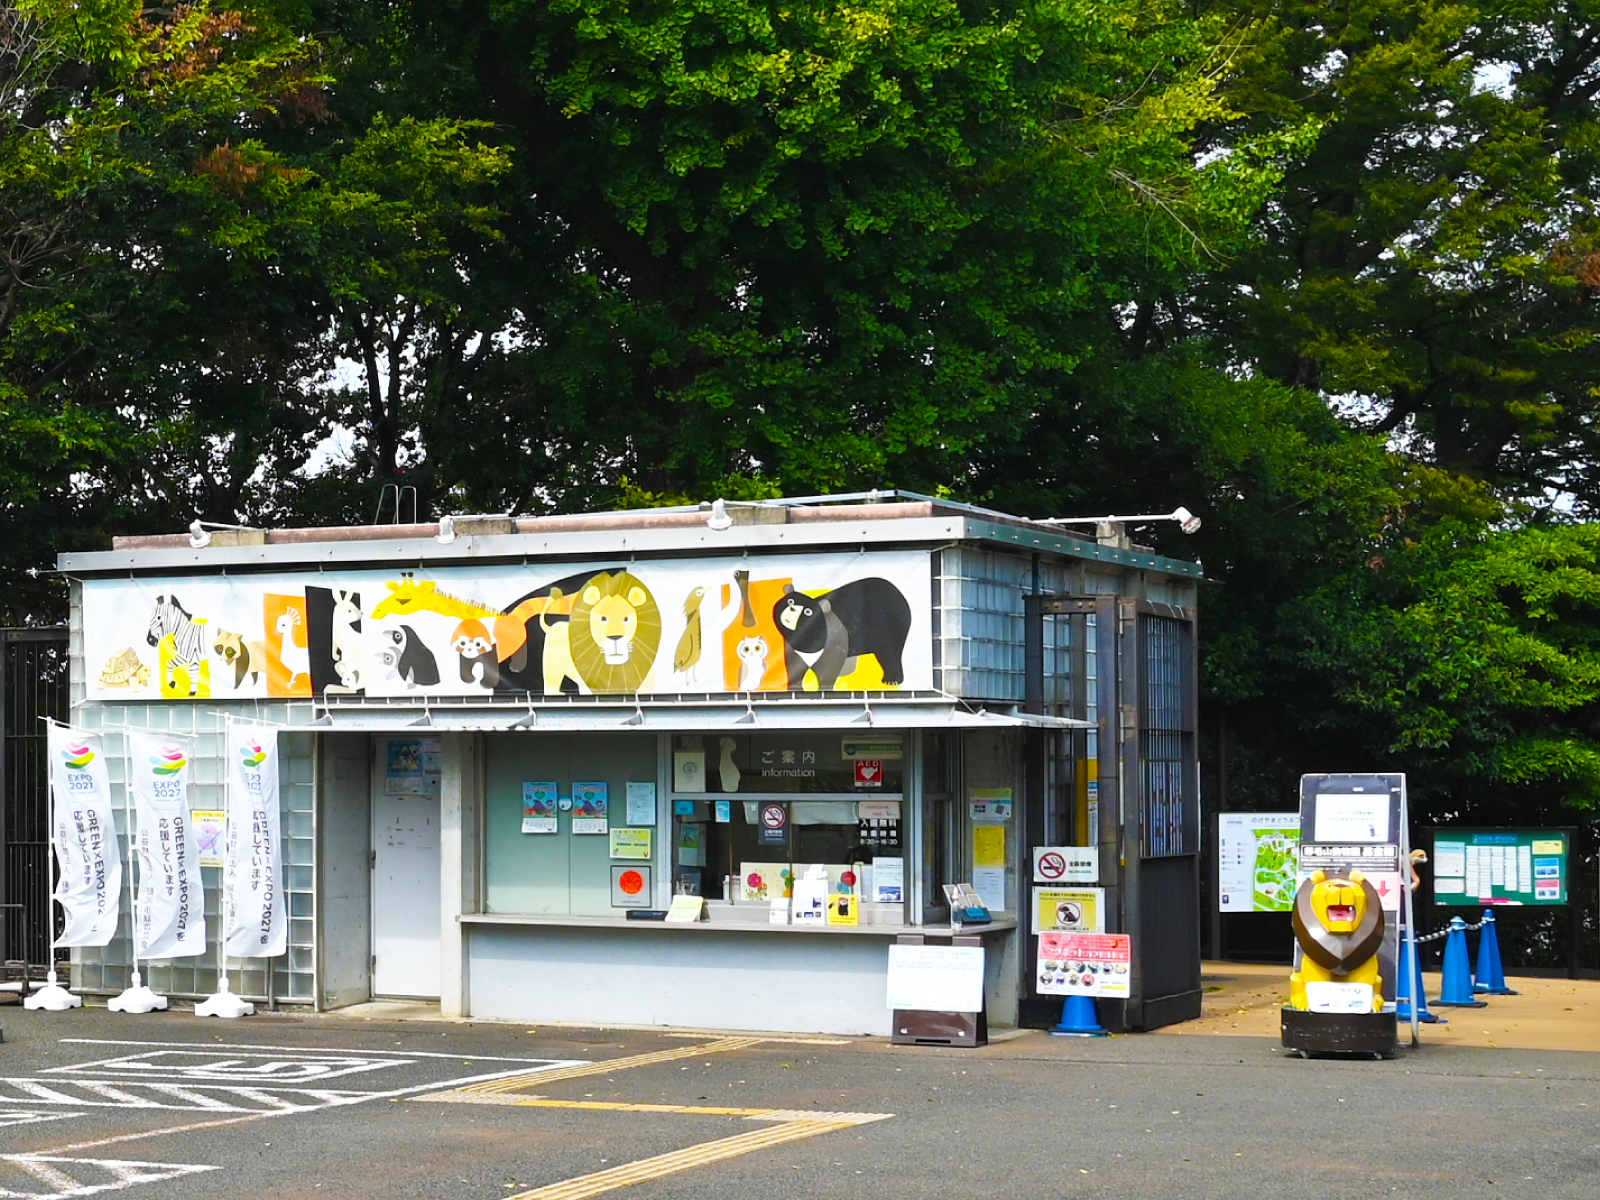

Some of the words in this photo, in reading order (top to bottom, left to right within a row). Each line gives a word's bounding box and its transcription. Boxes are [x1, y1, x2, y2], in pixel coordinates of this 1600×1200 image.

[762, 750, 815, 764] ご案内
[762, 767, 815, 777] information
[67, 774, 92, 782] EXPO
[69, 782, 93, 790] 2027
[153, 780, 180, 790] EXPO
[155, 789, 181, 797] 2027
